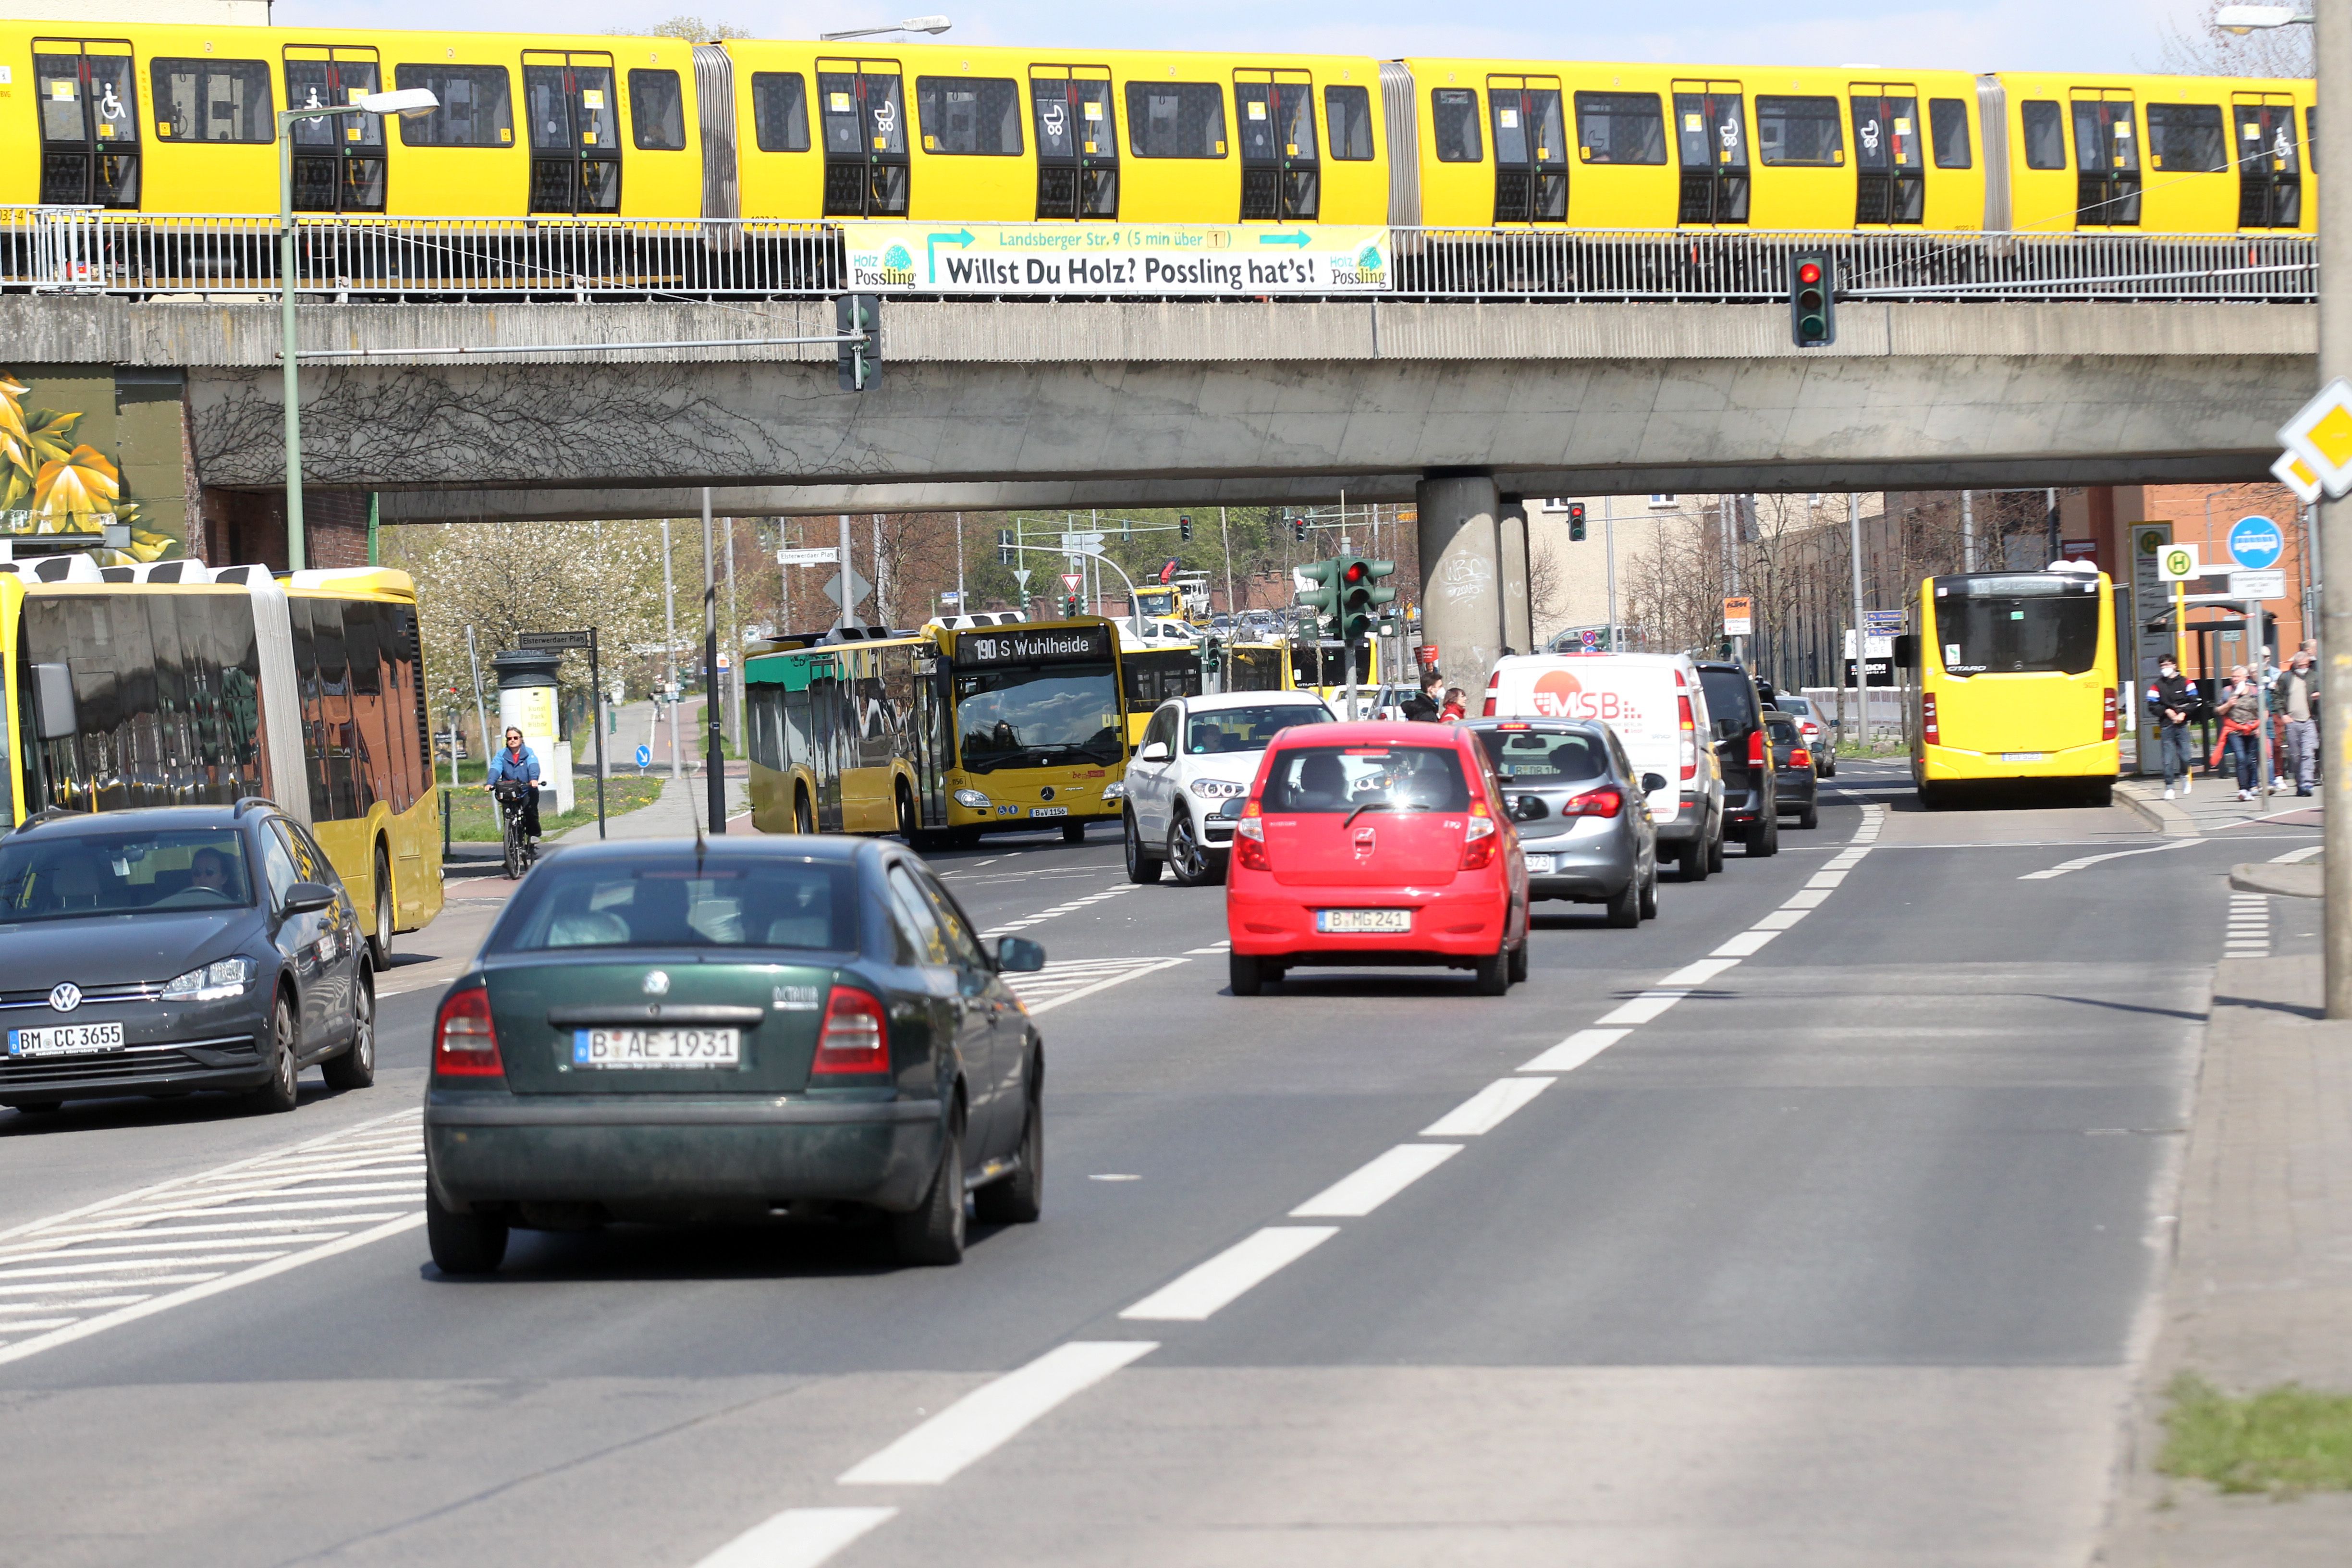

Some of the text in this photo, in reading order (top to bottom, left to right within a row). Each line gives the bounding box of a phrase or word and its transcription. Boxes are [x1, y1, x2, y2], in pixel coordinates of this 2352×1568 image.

[1000, 232, 1081, 250] Landsberger
[1087, 232, 1110, 246] Str.
[1127, 230, 1140, 247] (5
[1146, 232, 1170, 245] min
[1175, 232, 1203, 246] über
[854, 255, 878, 267] Holz
[1331, 256, 1353, 268] Holz
[855, 269, 917, 289] Possling
[946, 257, 1019, 284] Willst
[1027, 258, 1060, 284] Du
[1069, 257, 1136, 283] Holz?
[1145, 257, 1243, 290] Possling
[1331, 269, 1386, 288] Possling
[974, 636, 1089, 660] 190 S Wuhlheide
[1333, 912, 1403, 926] B MG 241
[20, 1026, 120, 1050] BM CC 3655
[593, 1030, 734, 1057] B AE 1931
